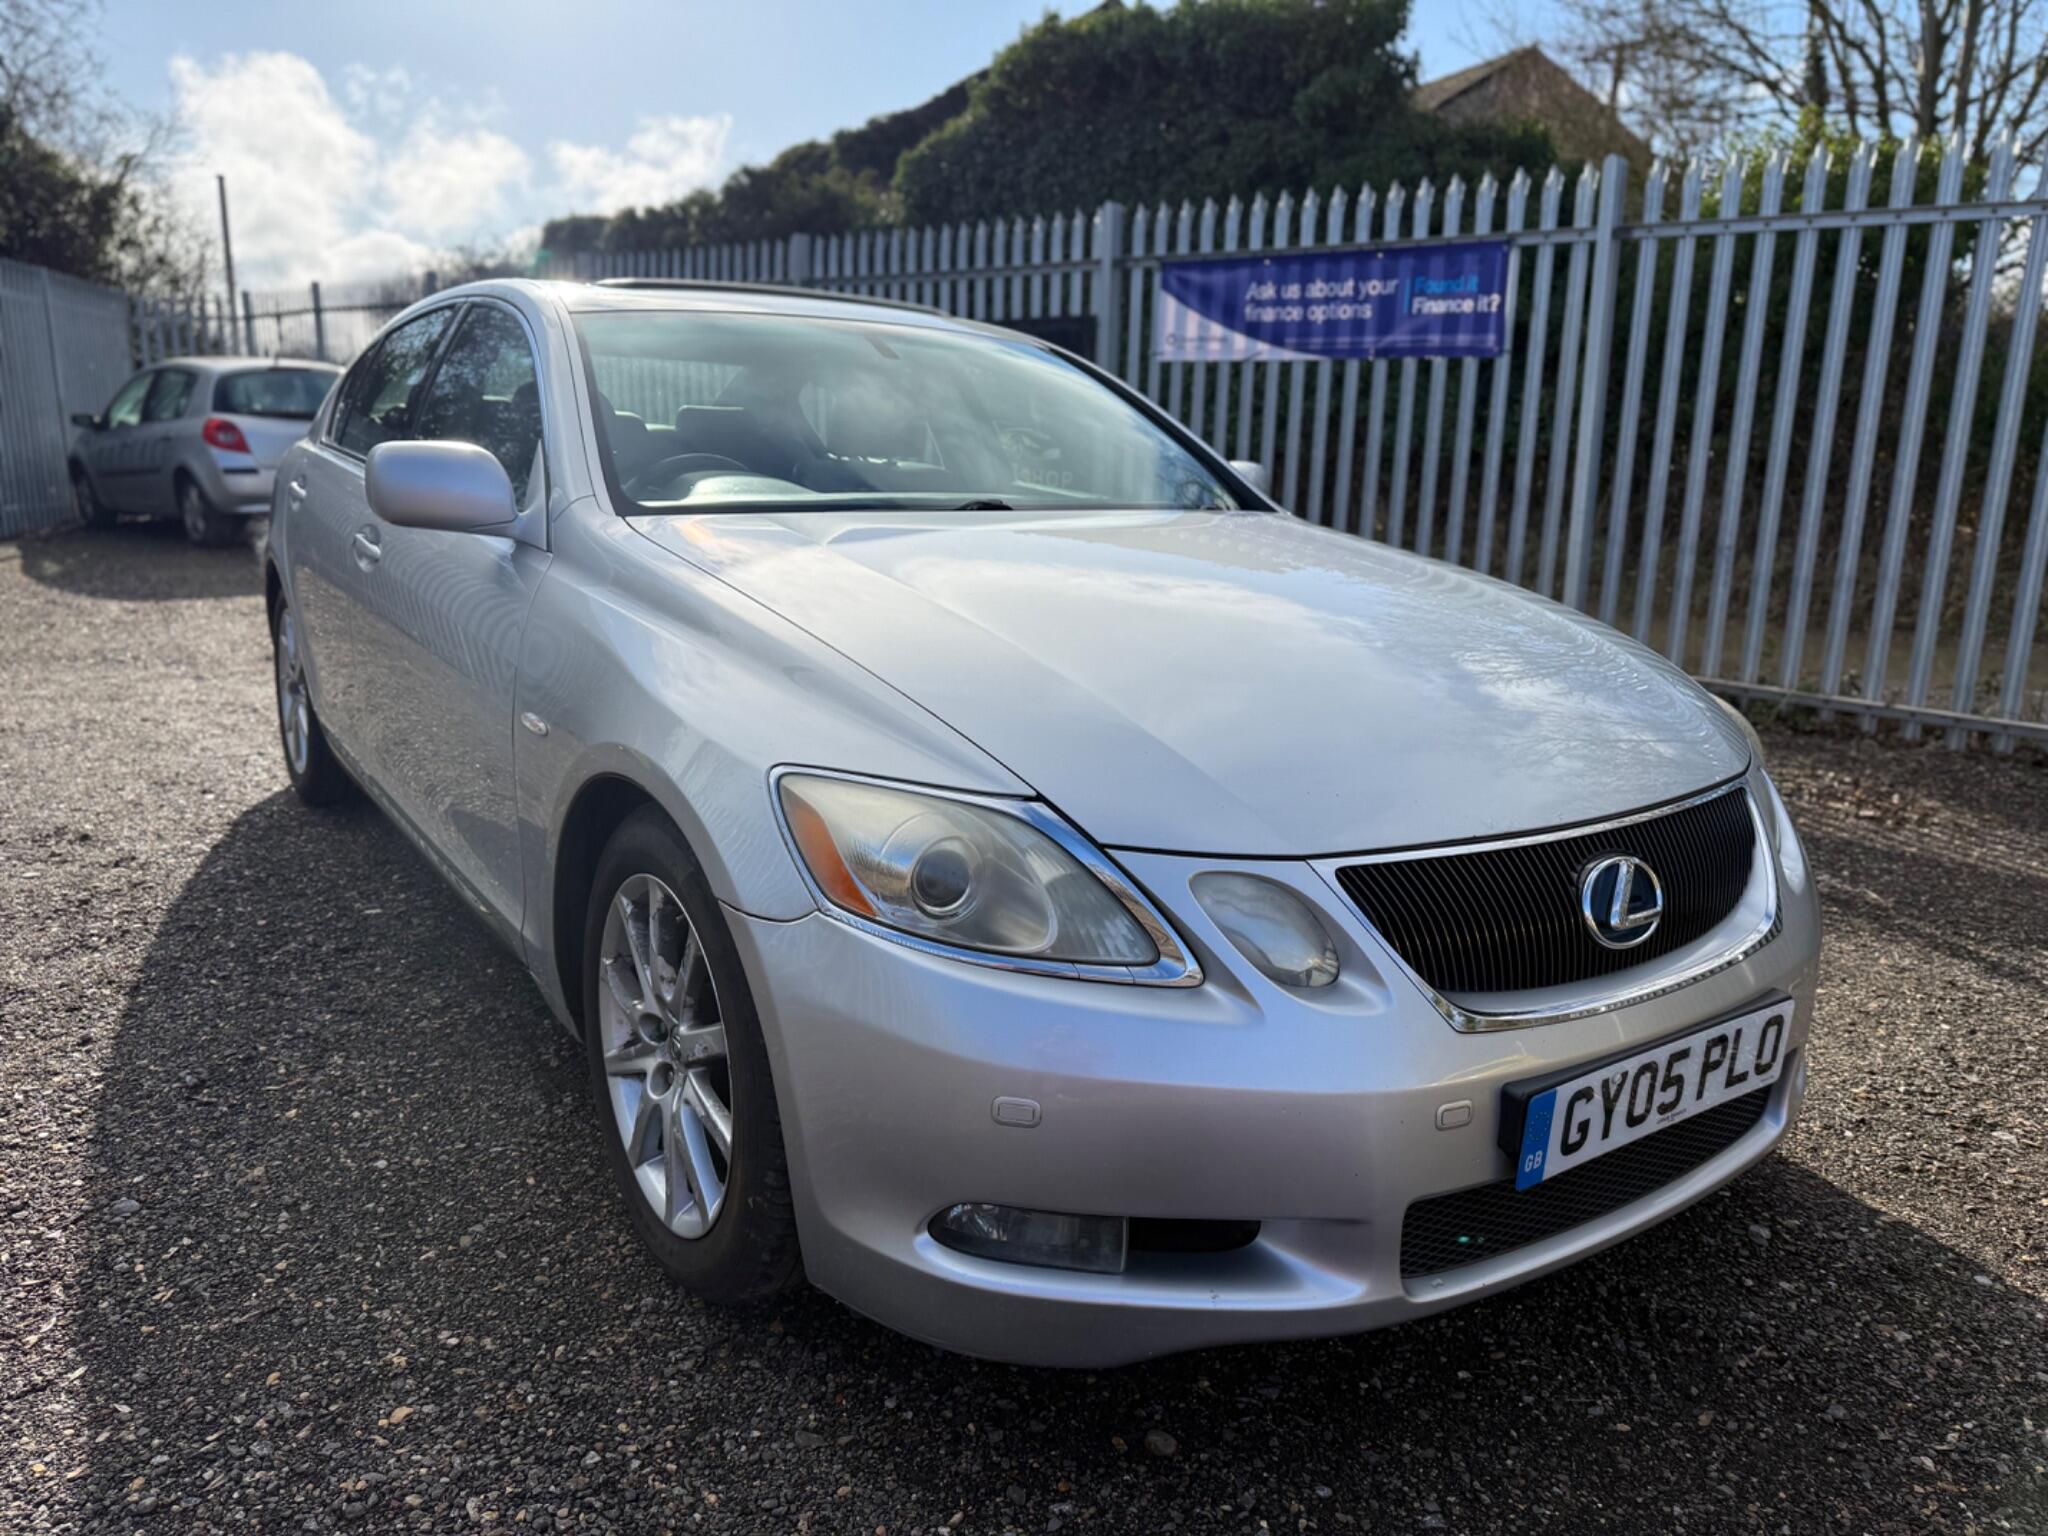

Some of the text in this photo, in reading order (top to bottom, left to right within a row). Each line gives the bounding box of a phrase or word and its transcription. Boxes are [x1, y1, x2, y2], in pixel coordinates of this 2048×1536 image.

[1246, 278, 1399, 301] Ask us about your
[1415, 275, 1465, 294] Found
[1245, 303, 1373, 324] finance options
[1412, 293, 1501, 315] Finance it?
[1560, 1046, 1692, 1157] GY05
[1524, 1150, 1543, 1172] GB
